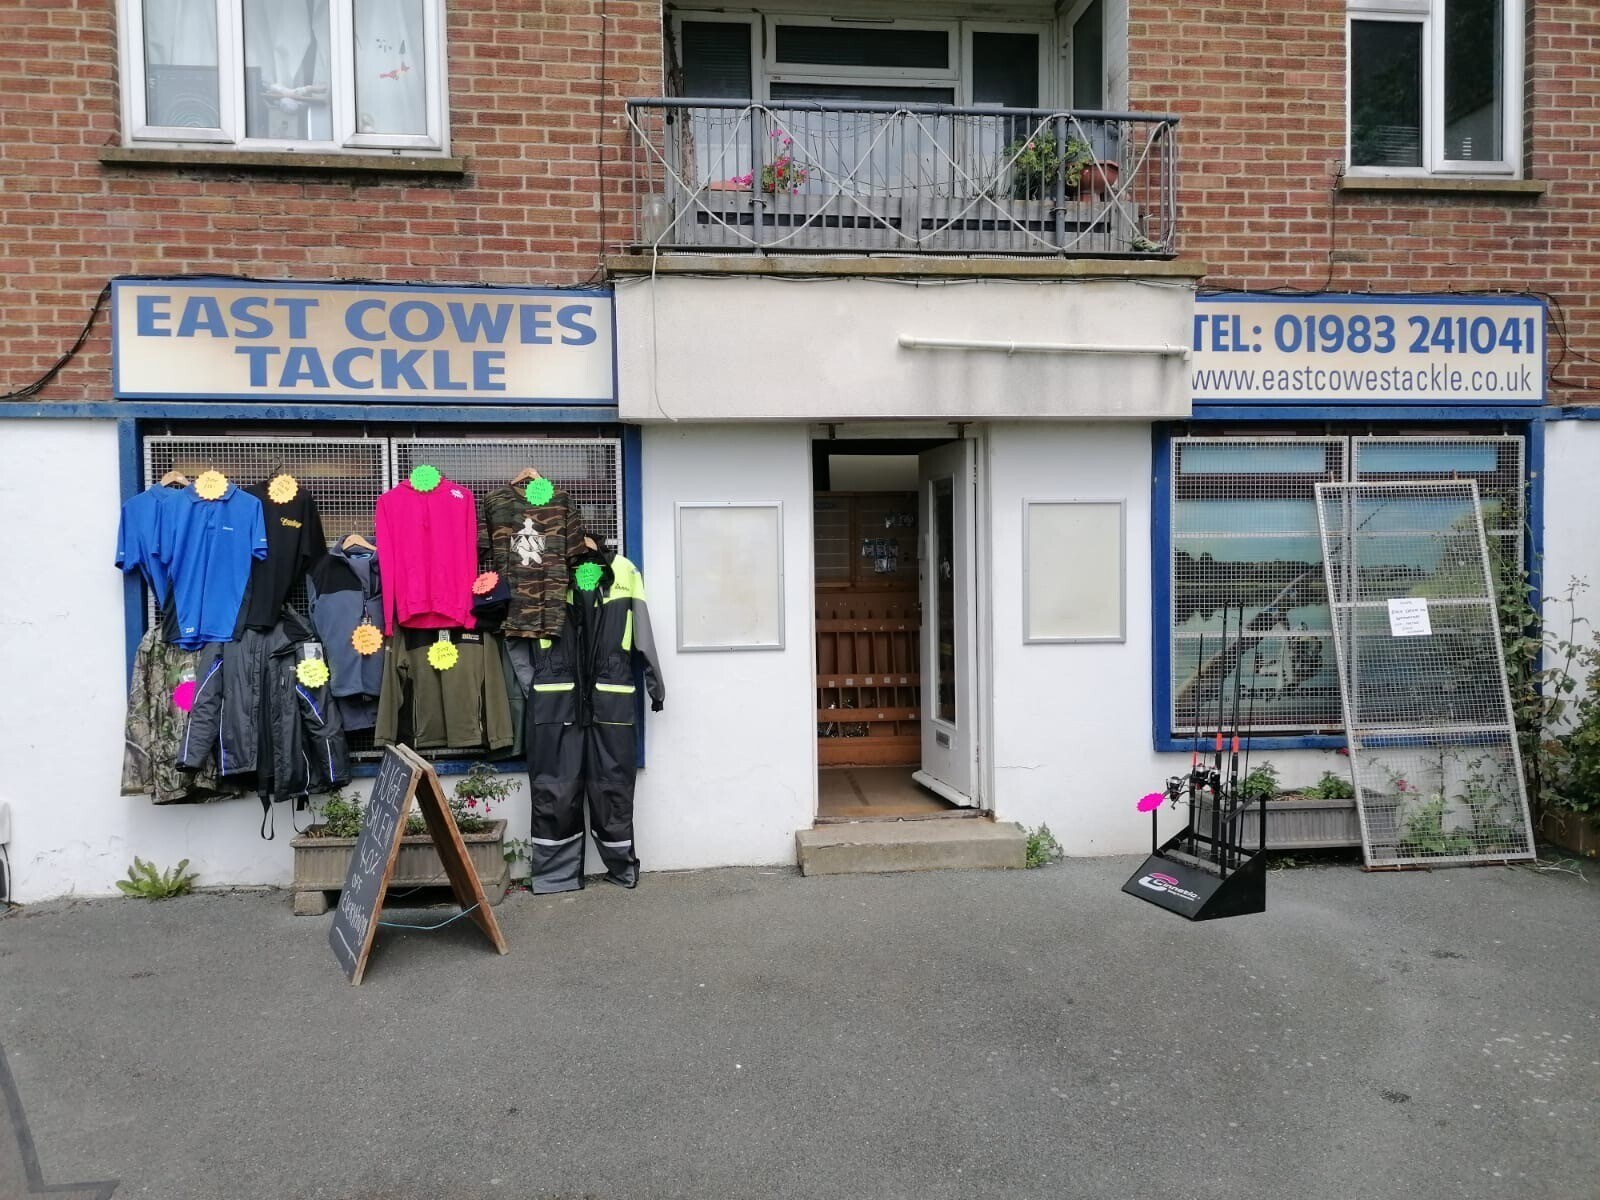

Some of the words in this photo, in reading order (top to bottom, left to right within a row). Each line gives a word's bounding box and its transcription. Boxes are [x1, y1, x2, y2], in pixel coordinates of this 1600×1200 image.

[136, 295, 320, 340] EAST
[344, 299, 598, 346] COWES
[1193, 314, 1262, 353] TEL:
[1274, 314, 1396, 353] 01983
[1407, 315, 1535, 355] 241041
[234, 345, 507, 391] TACKLE
[1191, 362, 1532, 392] www.eastcowestackle.co.uk
[375, 753, 408, 814] HUGE
